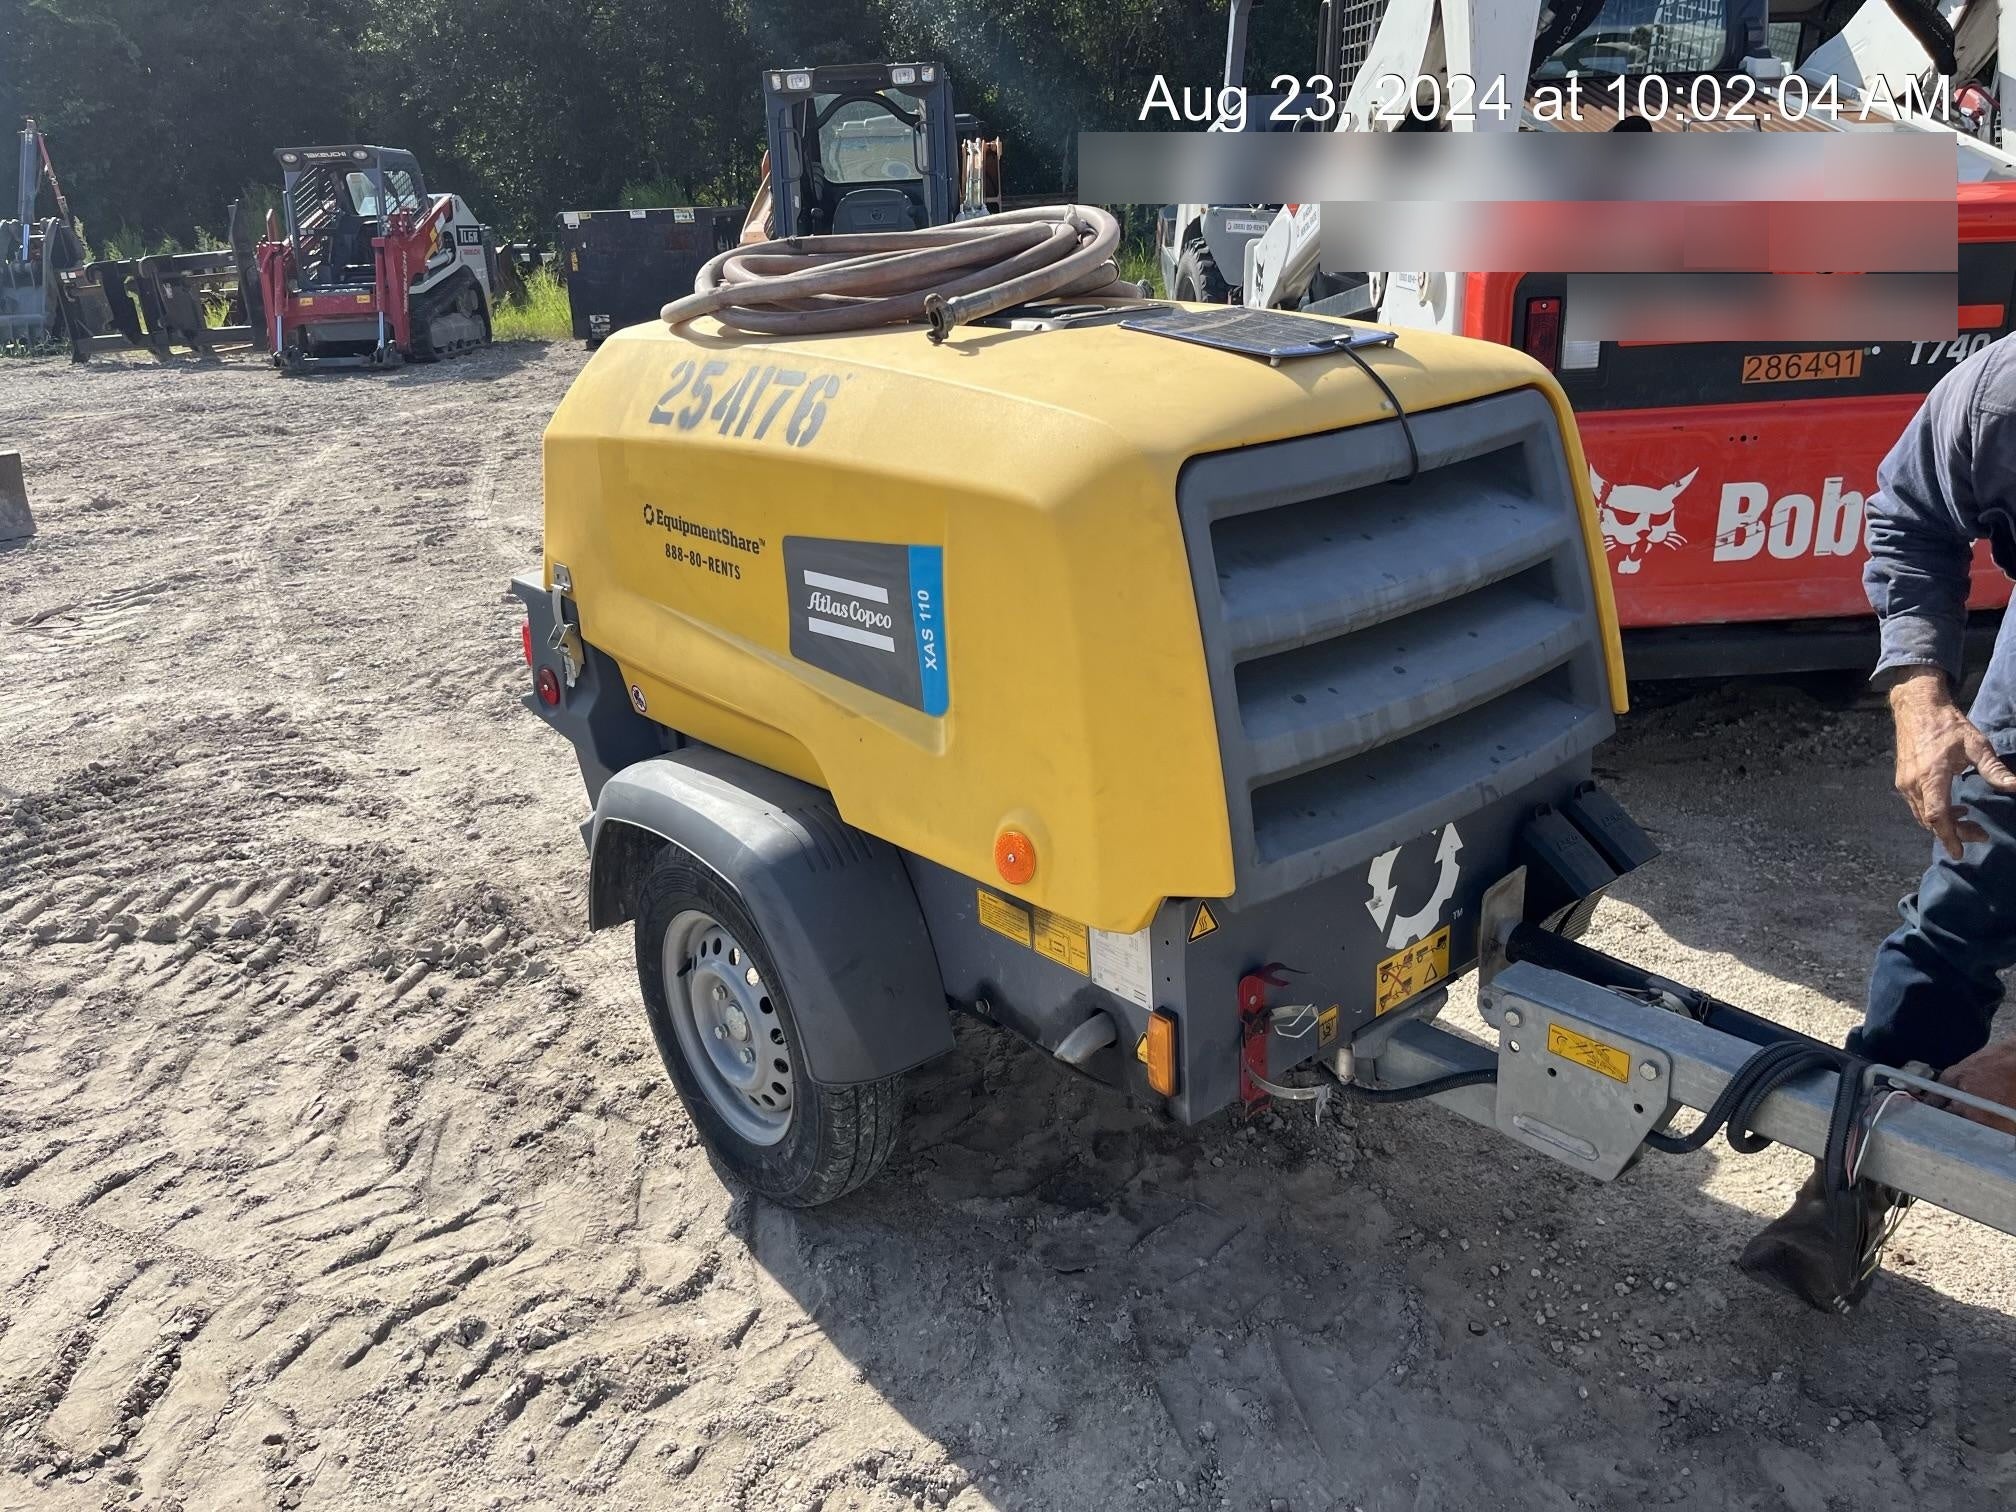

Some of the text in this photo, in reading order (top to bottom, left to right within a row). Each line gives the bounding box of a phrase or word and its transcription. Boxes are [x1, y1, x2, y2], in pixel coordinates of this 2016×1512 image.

[1744, 350, 1856, 382] 286491
[1910, 333, 1991, 365] T740
[649, 359, 841, 448] 254176
[656, 508, 760, 555] EquipmentShare
[1713, 476, 1872, 562] Bob
[665, 543, 741, 580] 888-80-RENTS
[807, 591, 892, 629] Atlas Copco
[917, 589, 938, 672] XAS 110
